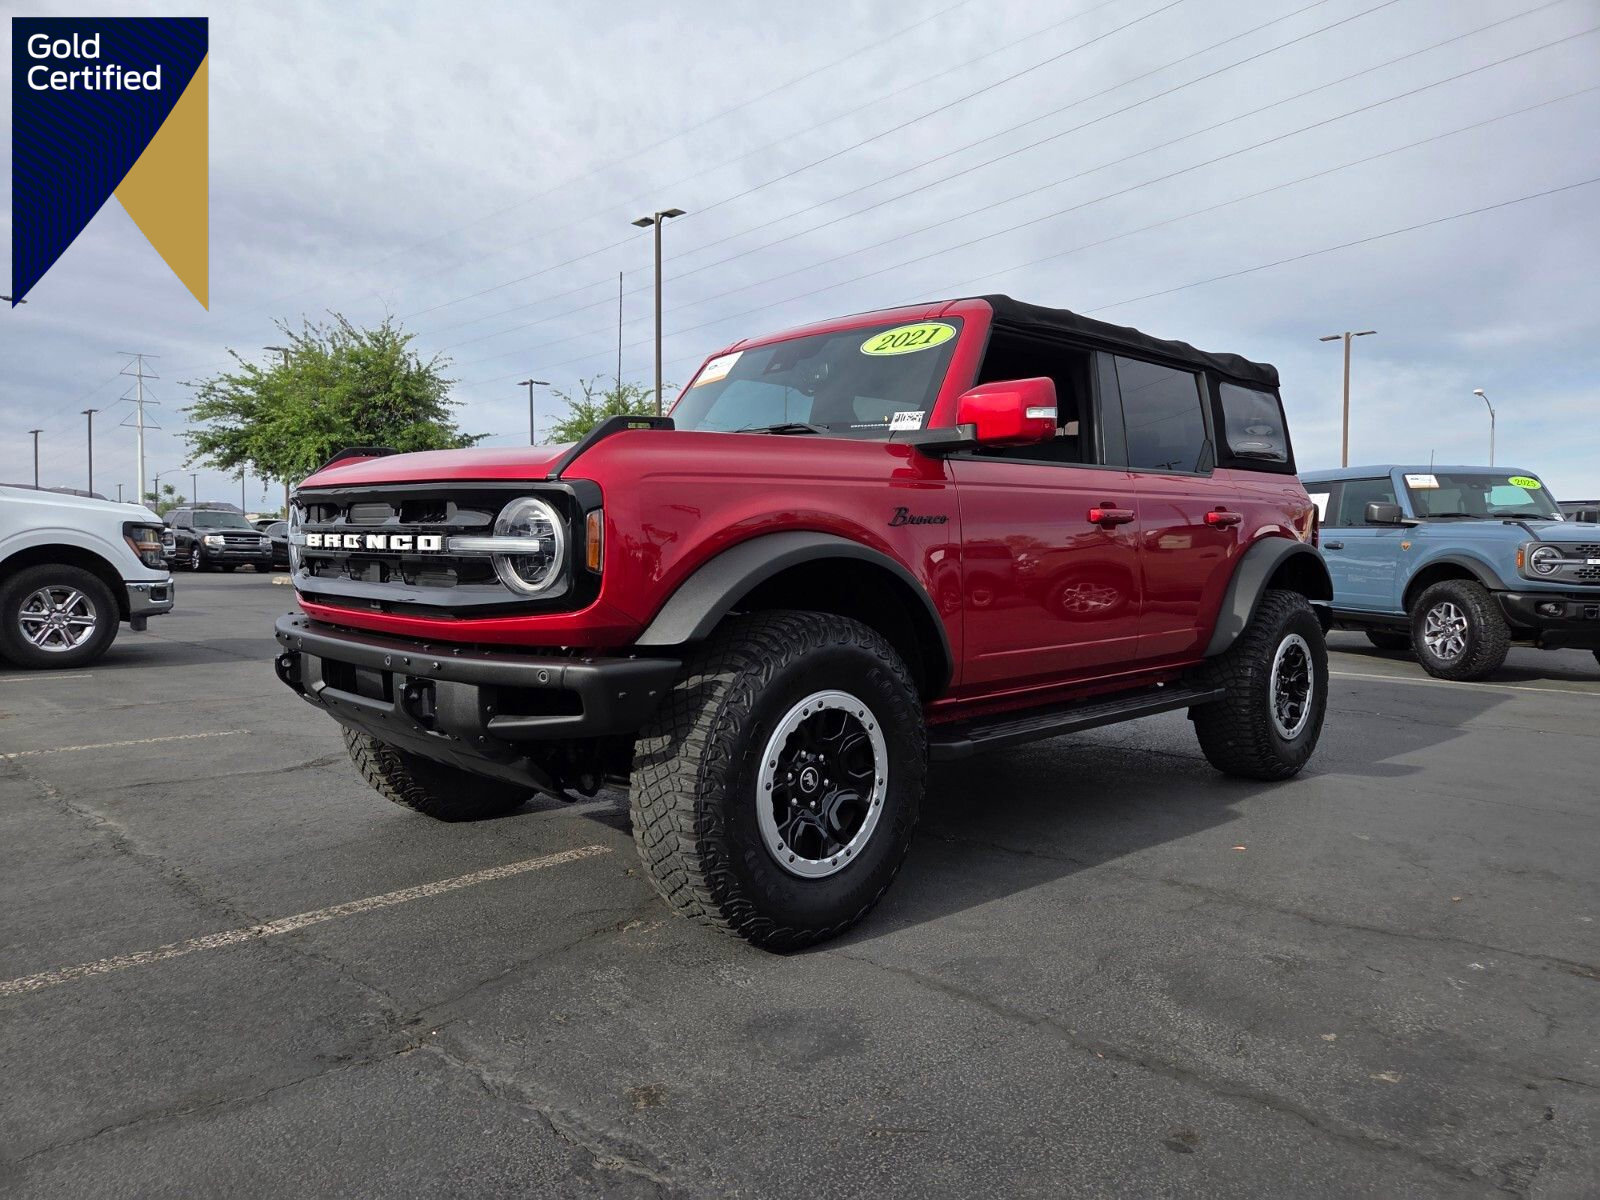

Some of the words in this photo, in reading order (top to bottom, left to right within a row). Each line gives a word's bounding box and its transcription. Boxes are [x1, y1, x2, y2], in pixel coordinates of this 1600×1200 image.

[874, 327, 942, 351] 2021
[1514, 478, 1537, 488] 2025
[887, 506, 949, 527] Bronco
[306, 533, 442, 551] BRONCO
